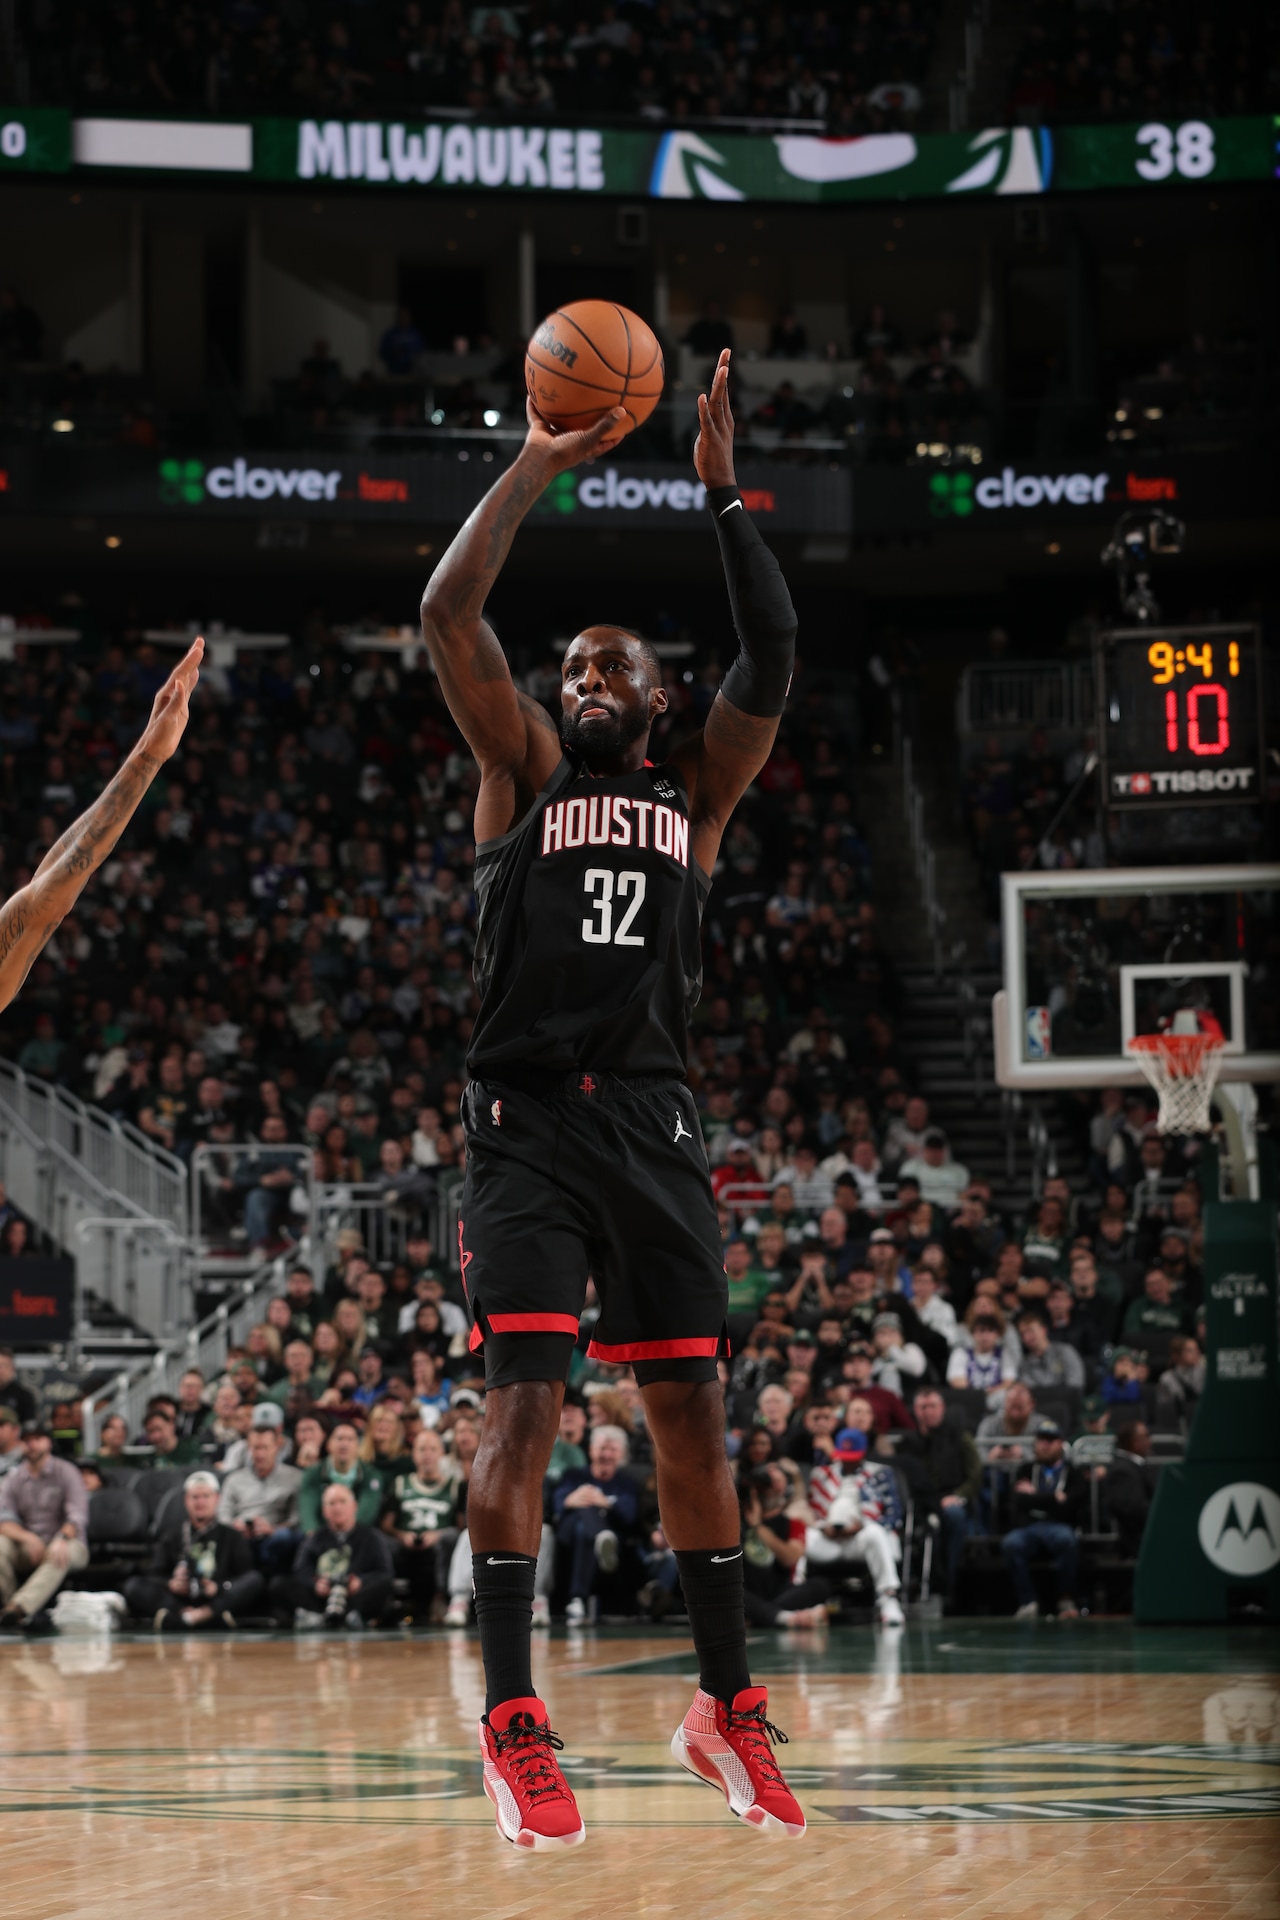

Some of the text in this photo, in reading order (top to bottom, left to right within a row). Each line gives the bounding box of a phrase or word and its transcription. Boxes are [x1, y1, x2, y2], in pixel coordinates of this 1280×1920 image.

[297, 120, 605, 190] MILWAUKEE
[1135, 120, 1216, 181] 38
[206, 457, 342, 500] clover
[578, 467, 708, 511] clover
[975, 466, 1109, 508] clover
[1148, 641, 1240, 684] 9:41
[1165, 683, 1230, 755] 10
[1151, 767, 1254, 793] TISSOT
[541, 795, 689, 869] HOUSTON
[581, 868, 647, 947] 32
